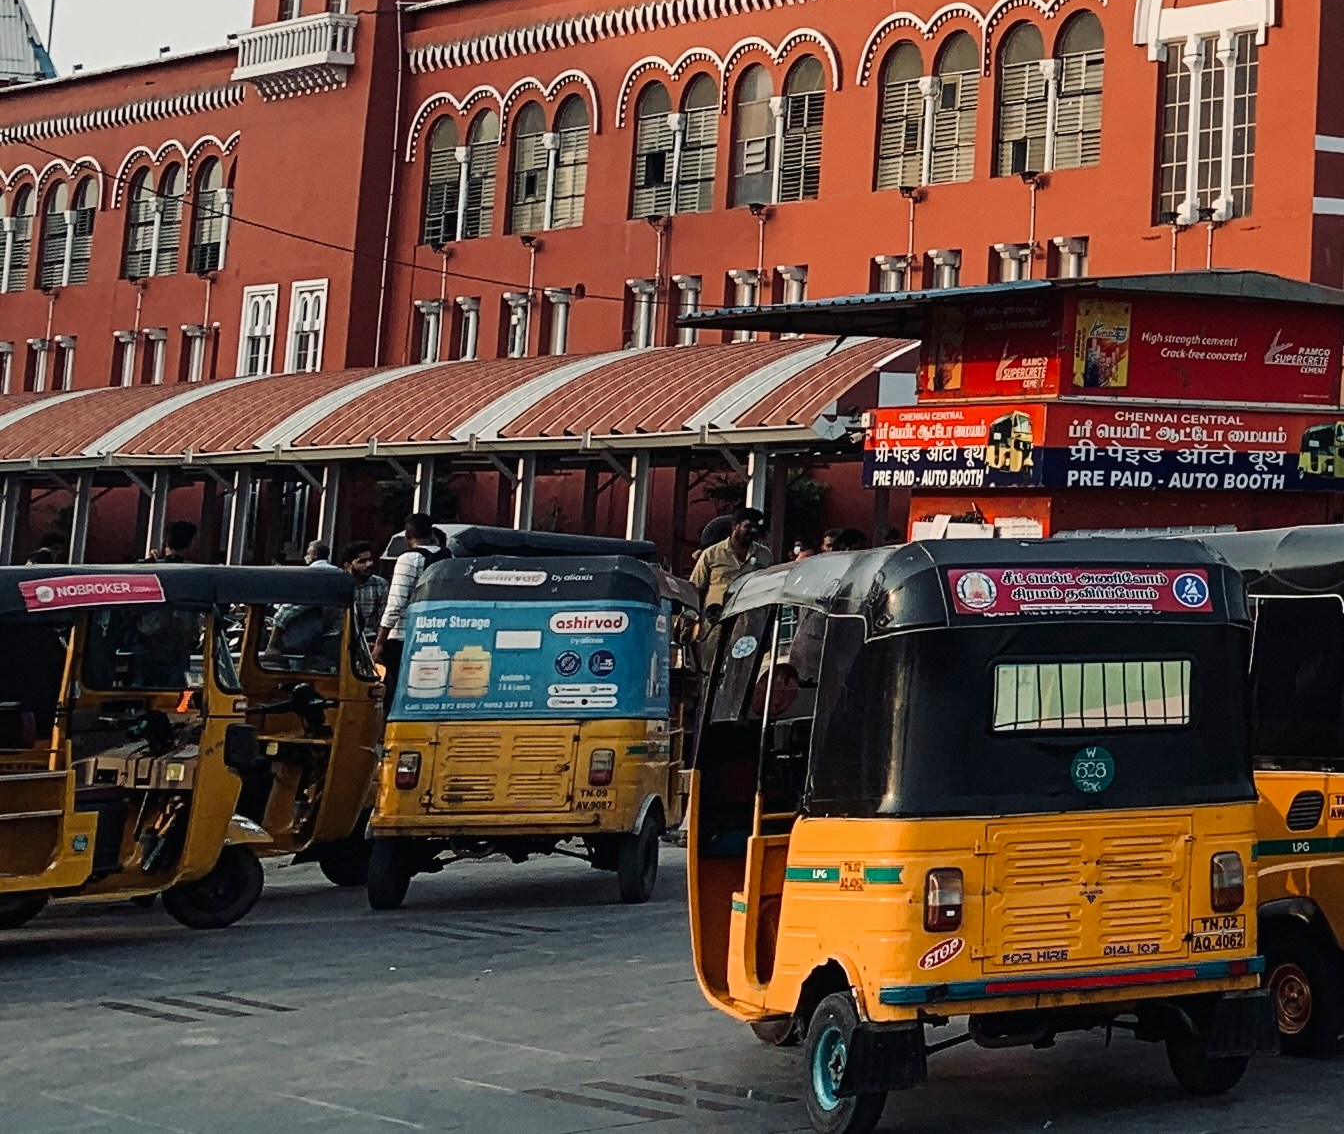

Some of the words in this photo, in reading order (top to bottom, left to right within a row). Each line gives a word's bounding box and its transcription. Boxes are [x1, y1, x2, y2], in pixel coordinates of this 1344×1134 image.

[1142, 332, 1163, 345] High
[1163, 334, 1201, 346] strength
[1202, 337, 1238, 347] cement!
[1160, 348, 1205, 360] Crack-free
[1206, 351, 1247, 362] concrete!
[1298, 347, 1331, 356] RAMCO
[1274, 354, 1329, 365] SUPERCRETE
[1022, 379, 1045, 388] CEMET
[899, 412, 931, 421] CHENNAI
[931, 411, 964, 420] CENTRAL
[1114, 412, 1178, 423] CHENNAI
[1180, 414, 1244, 425] CENTRAL
[1096, 423, 1151, 439] பெயிட்
[1155, 426, 1225, 444] ஆட்டோ
[1228, 426, 1287, 444] மையம்
[926, 440, 959, 462] ऑटो
[963, 444, 985, 467] बूथ
[1068, 439, 1164, 466] प्री-पेइड
[1176, 443, 1237, 466] ऑटो
[1248, 449, 1286, 471] बूथ
[873, 470, 891, 486] PRE
[893, 470, 915, 486] PAID
[921, 470, 948, 486] AUTO
[950, 469, 983, 487] BOOTH
[1067, 470, 1104, 487] PRE
[1110, 471, 1152, 488] PAID
[1168, 472, 1218, 489] AUTO
[1223, 473, 1285, 490] BOOTH
[551, 574, 562, 582] by
[1002, 570, 1026, 586] சீட்
[1027, 571, 1075, 585] பெல்ட்
[1077, 571, 1169, 585] அணிவோம்
[57, 583, 131, 597] NOBROKER
[1012, 587, 1062, 601] சிரமம்
[1064, 587, 1159, 603] தவிர்ப்போம்
[416, 616, 447, 628] Water
[449, 615, 491, 630] Storage
[556, 616, 623, 629] ashirvad
[415, 631, 438, 643] Tank
[1086, 747, 1097, 758] W
[1076, 761, 1106, 778] 828
[1292, 842, 1310, 853] LPG
[812, 869, 828, 879] LPG
[1201, 916, 1238, 931] TN.02
[1193, 934, 1243, 951] AQ.4062
[924, 938, 960, 969] STOP
[1002, 953, 1032, 964] FOR
[1037, 949, 1069, 961] HIRE
